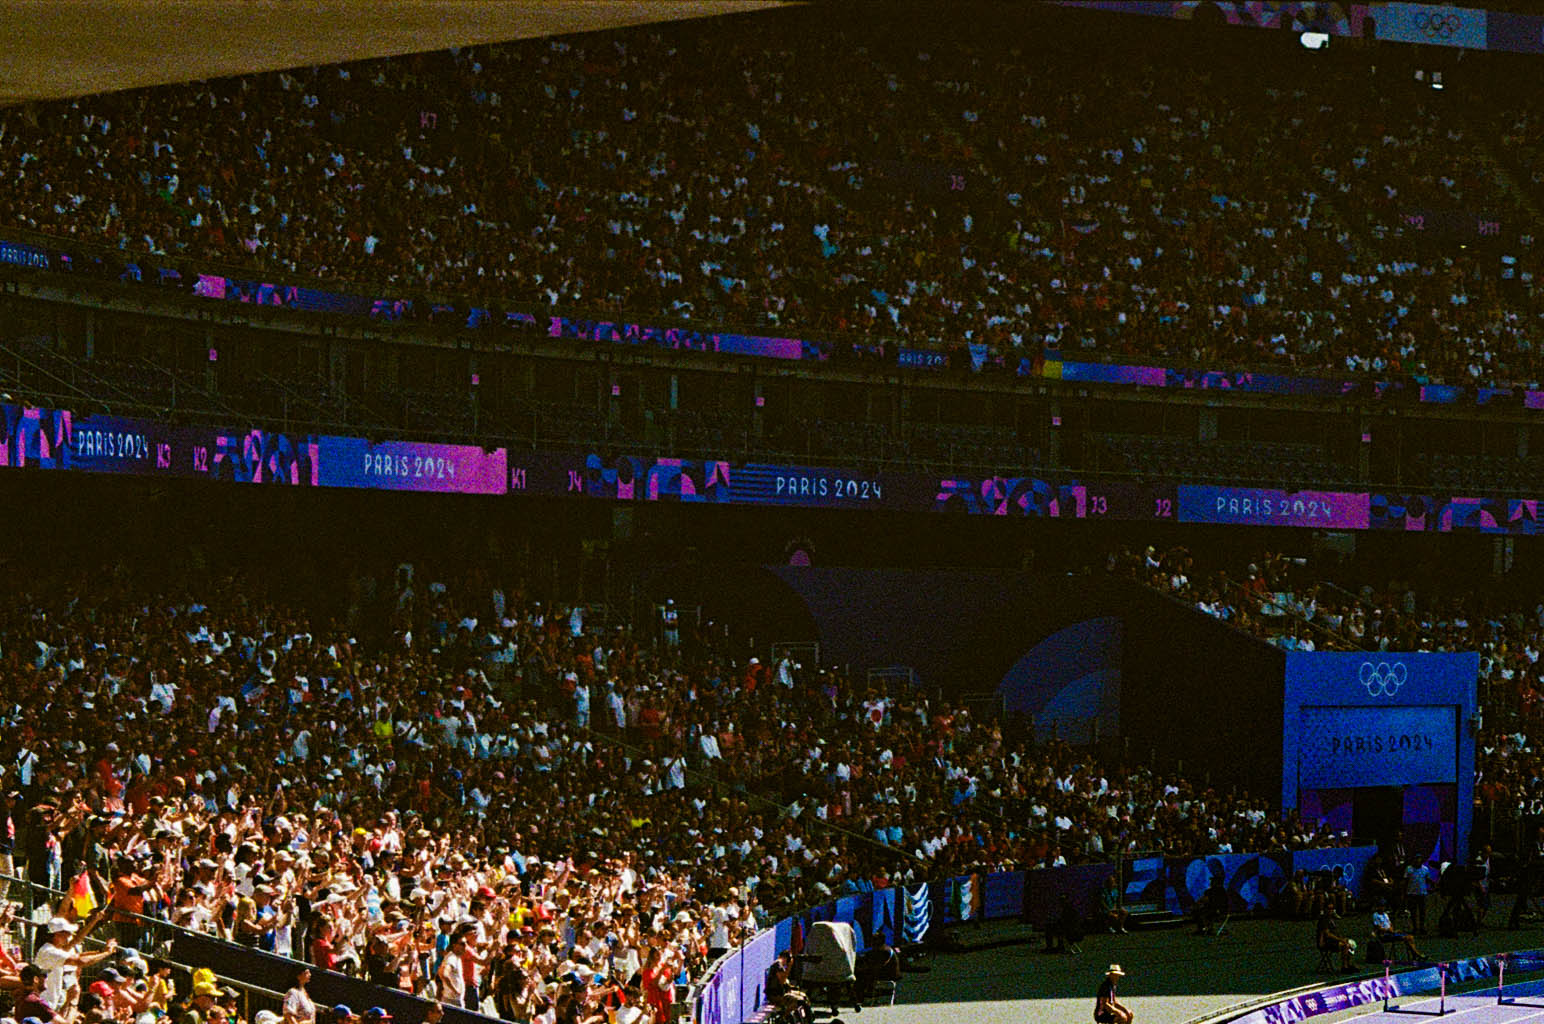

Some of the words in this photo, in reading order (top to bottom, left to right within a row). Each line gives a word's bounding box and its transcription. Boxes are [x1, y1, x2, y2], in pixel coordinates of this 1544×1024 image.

[78, 430, 115, 457] PARIS
[116, 432, 149, 459] 2024
[156, 442, 172, 469] K3
[192, 445, 208, 472] K2
[364, 452, 409, 478] PARIS
[414, 456, 456, 479] 2024
[776, 476, 828, 496] PARIS
[834, 478, 882, 499] 2024
[1216, 496, 1273, 516] PARIS
[1279, 499, 1332, 518] 2024
[1332, 734, 1383, 754] PARIS
[1388, 733, 1433, 753] 2024
